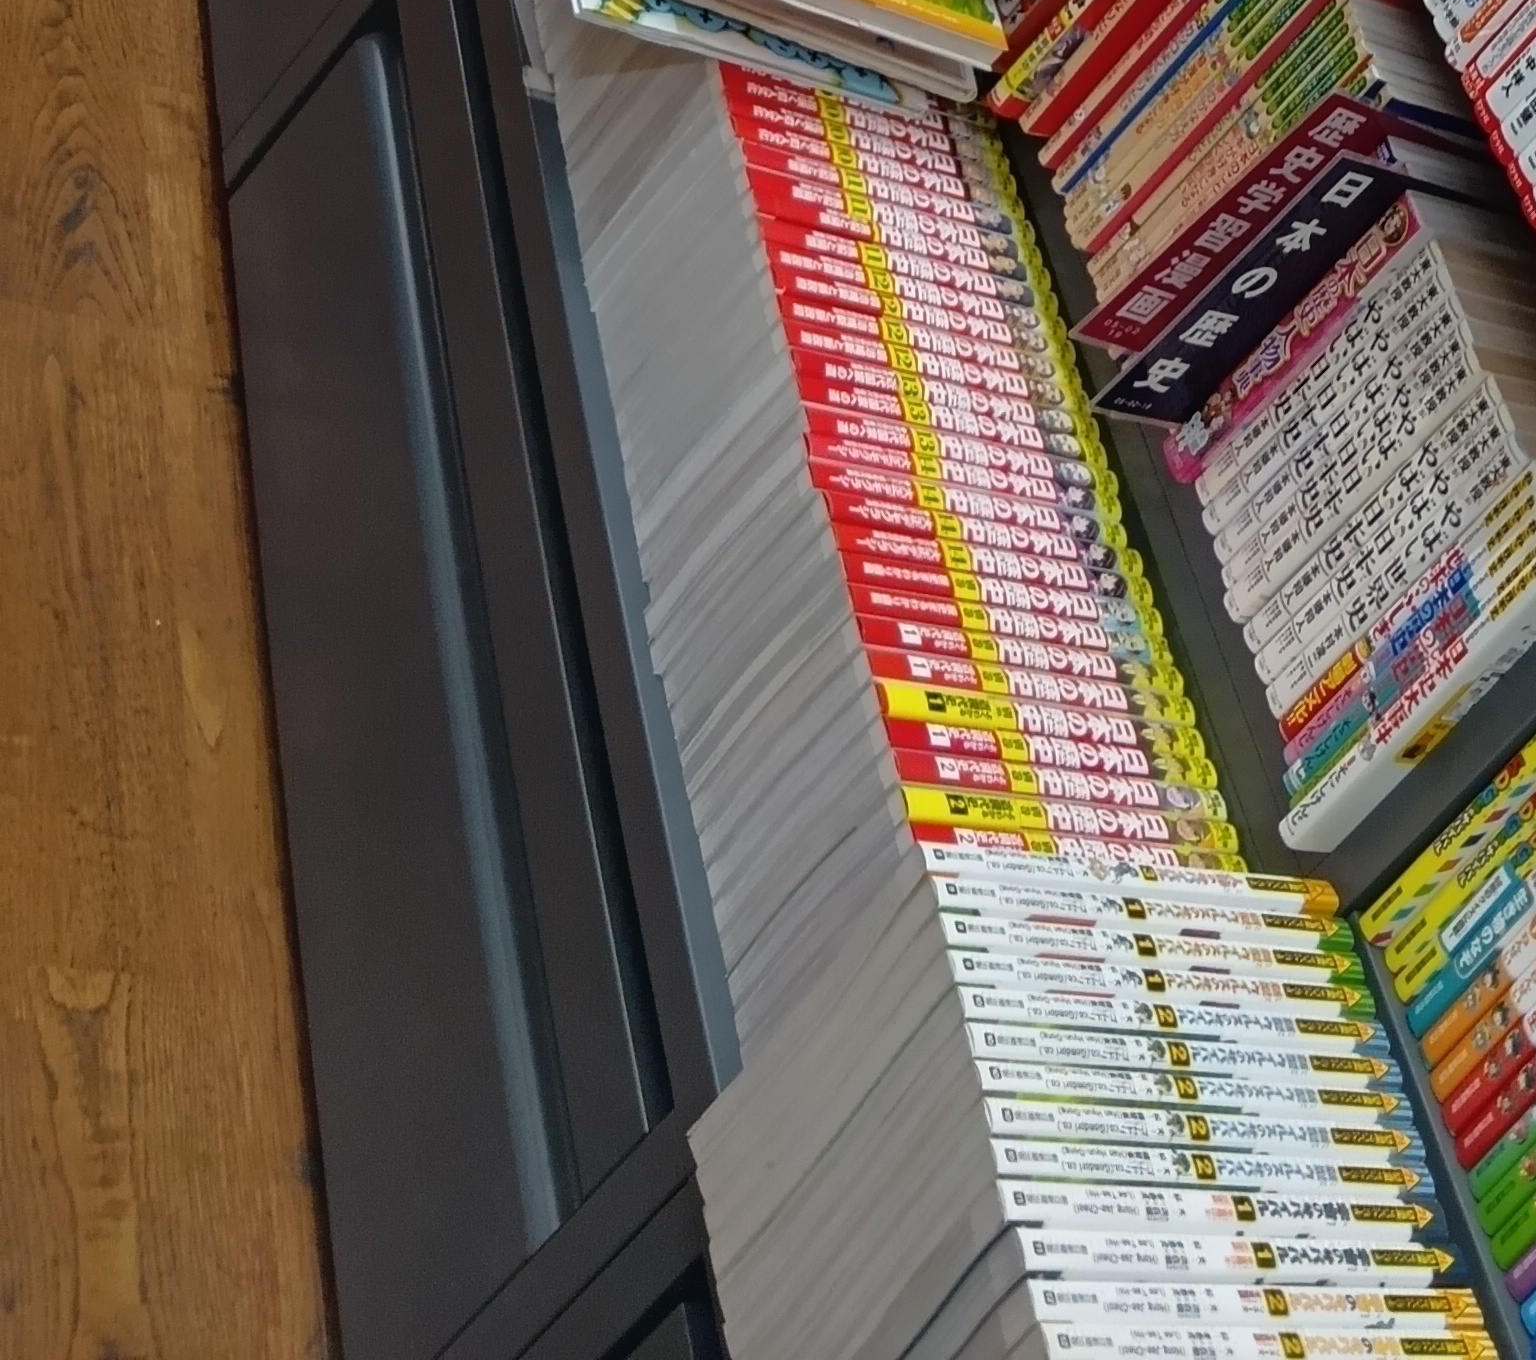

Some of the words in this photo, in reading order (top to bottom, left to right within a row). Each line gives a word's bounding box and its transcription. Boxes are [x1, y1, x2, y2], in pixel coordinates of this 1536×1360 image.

[1120, 97, 1371, 329] 歴史学習漫画
